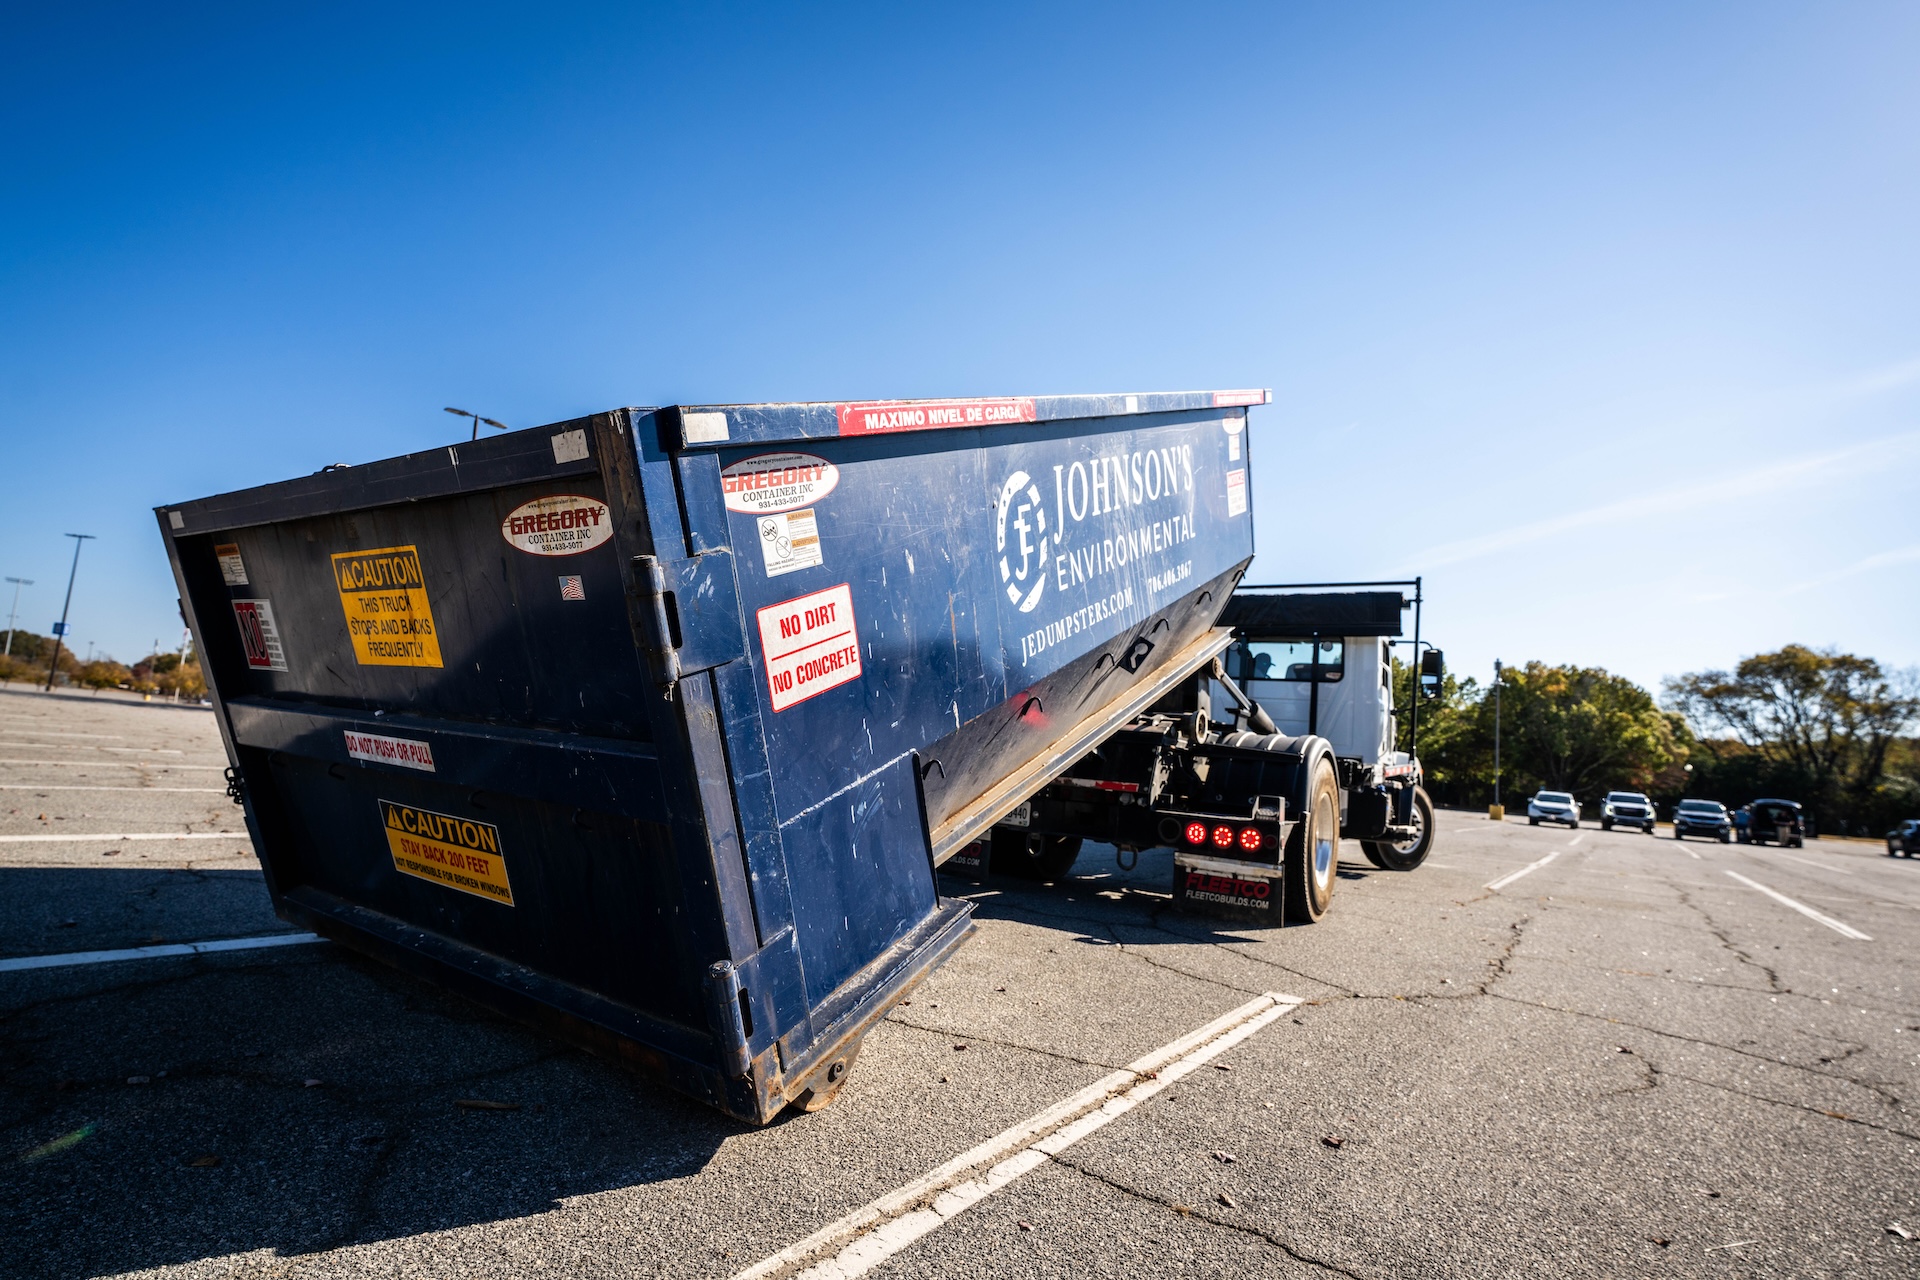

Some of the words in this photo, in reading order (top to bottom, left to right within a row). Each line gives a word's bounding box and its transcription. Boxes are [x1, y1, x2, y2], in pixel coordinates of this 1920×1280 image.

[864, 410, 925, 430] MAXIMO
[928, 408, 964, 425] NIVEL
[966, 407, 982, 422] DE
[985, 405, 1021, 420] CARGA
[721, 462, 828, 494] GREGORY
[742, 485, 797, 503] CONTAINER
[799, 483, 814, 494] INC
[758, 495, 805, 509] 931-433-5077
[1053, 444, 1193, 545] JOHNSON'S
[510, 505, 604, 535] GREGORY
[528, 530, 575, 545] CONTAINER
[577, 528, 592, 540] INC
[1055, 512, 1196, 592] ENVIRONMENTAL
[351, 555, 419, 588] CAUTION
[358, 597, 380, 613] THIS
[379, 595, 413, 613] TRUCK
[236, 609, 268, 660] NO
[350, 618, 379, 635] STOPS
[381, 619, 399, 635] AND
[401, 618, 432, 635] BACKS
[780, 614, 801, 639] NO
[804, 602, 836, 631] DIRT
[1021, 587, 1134, 667] JEDUMPSTERS.COM
[367, 641, 424, 658] FREQUENTLY
[772, 670, 793, 695] NO
[796, 645, 857, 685] CONCRETE
[345, 734, 358, 752] DO
[357, 737, 374, 755] NOT
[373, 739, 397, 759] PUSH
[396, 742, 411, 761] OR
[408, 744, 433, 765] PULL
[401, 807, 497, 853] CAUTION
[400, 838, 422, 858] STAY
[422, 843, 448, 865] BACK
[447, 850, 465, 871] 200
[465, 855, 490, 876] FEET
[395, 856, 407, 868] NOT
[406, 859, 443, 879] RESPONSIBLE
[442, 869, 453, 882] FOR
[453, 873, 480, 890] BROKEN
[479, 880, 510, 899] WINDOWS
[1185, 872, 1270, 899] FLEETCO
[1186, 889, 1269, 910] FLEETCOBUILDS.COM
